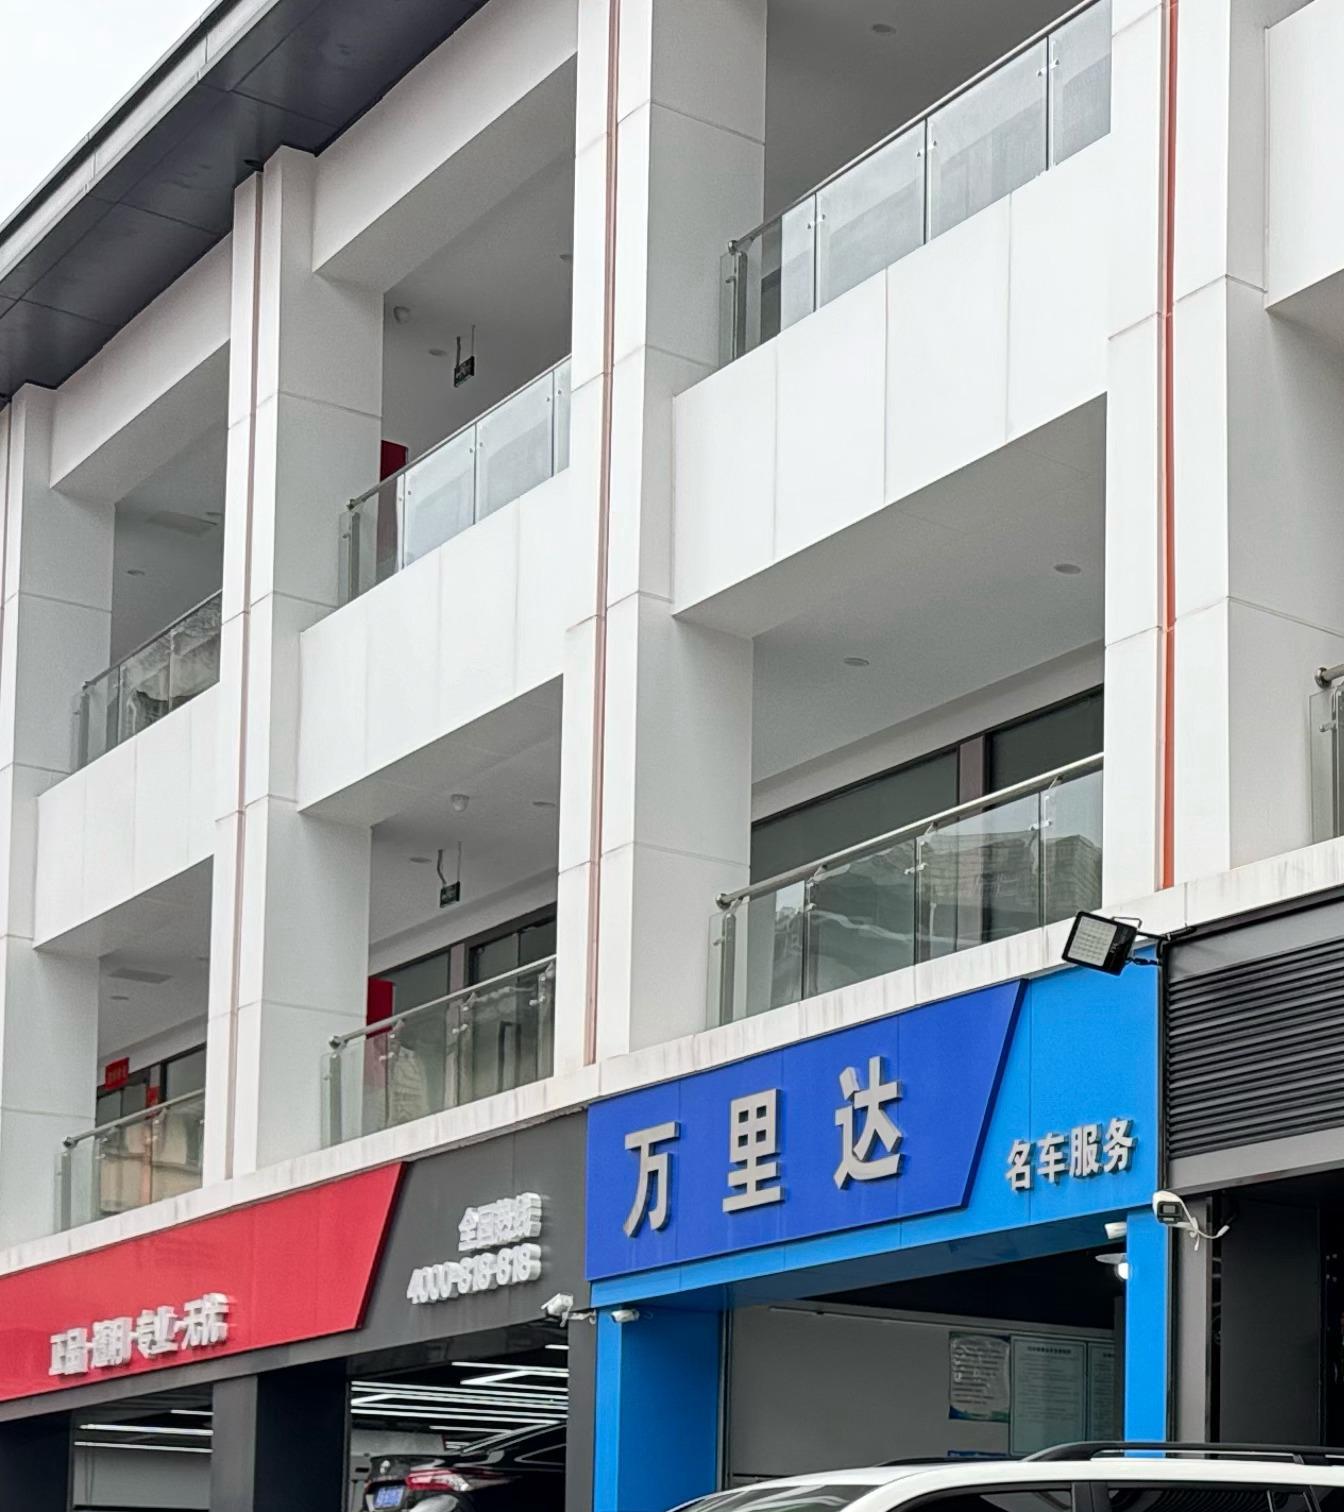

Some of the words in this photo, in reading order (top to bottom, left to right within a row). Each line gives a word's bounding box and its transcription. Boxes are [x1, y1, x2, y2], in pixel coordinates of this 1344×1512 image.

[623, 1055, 904, 1238] 万里达
[1005, 1117, 1137, 1193] 名车服务
